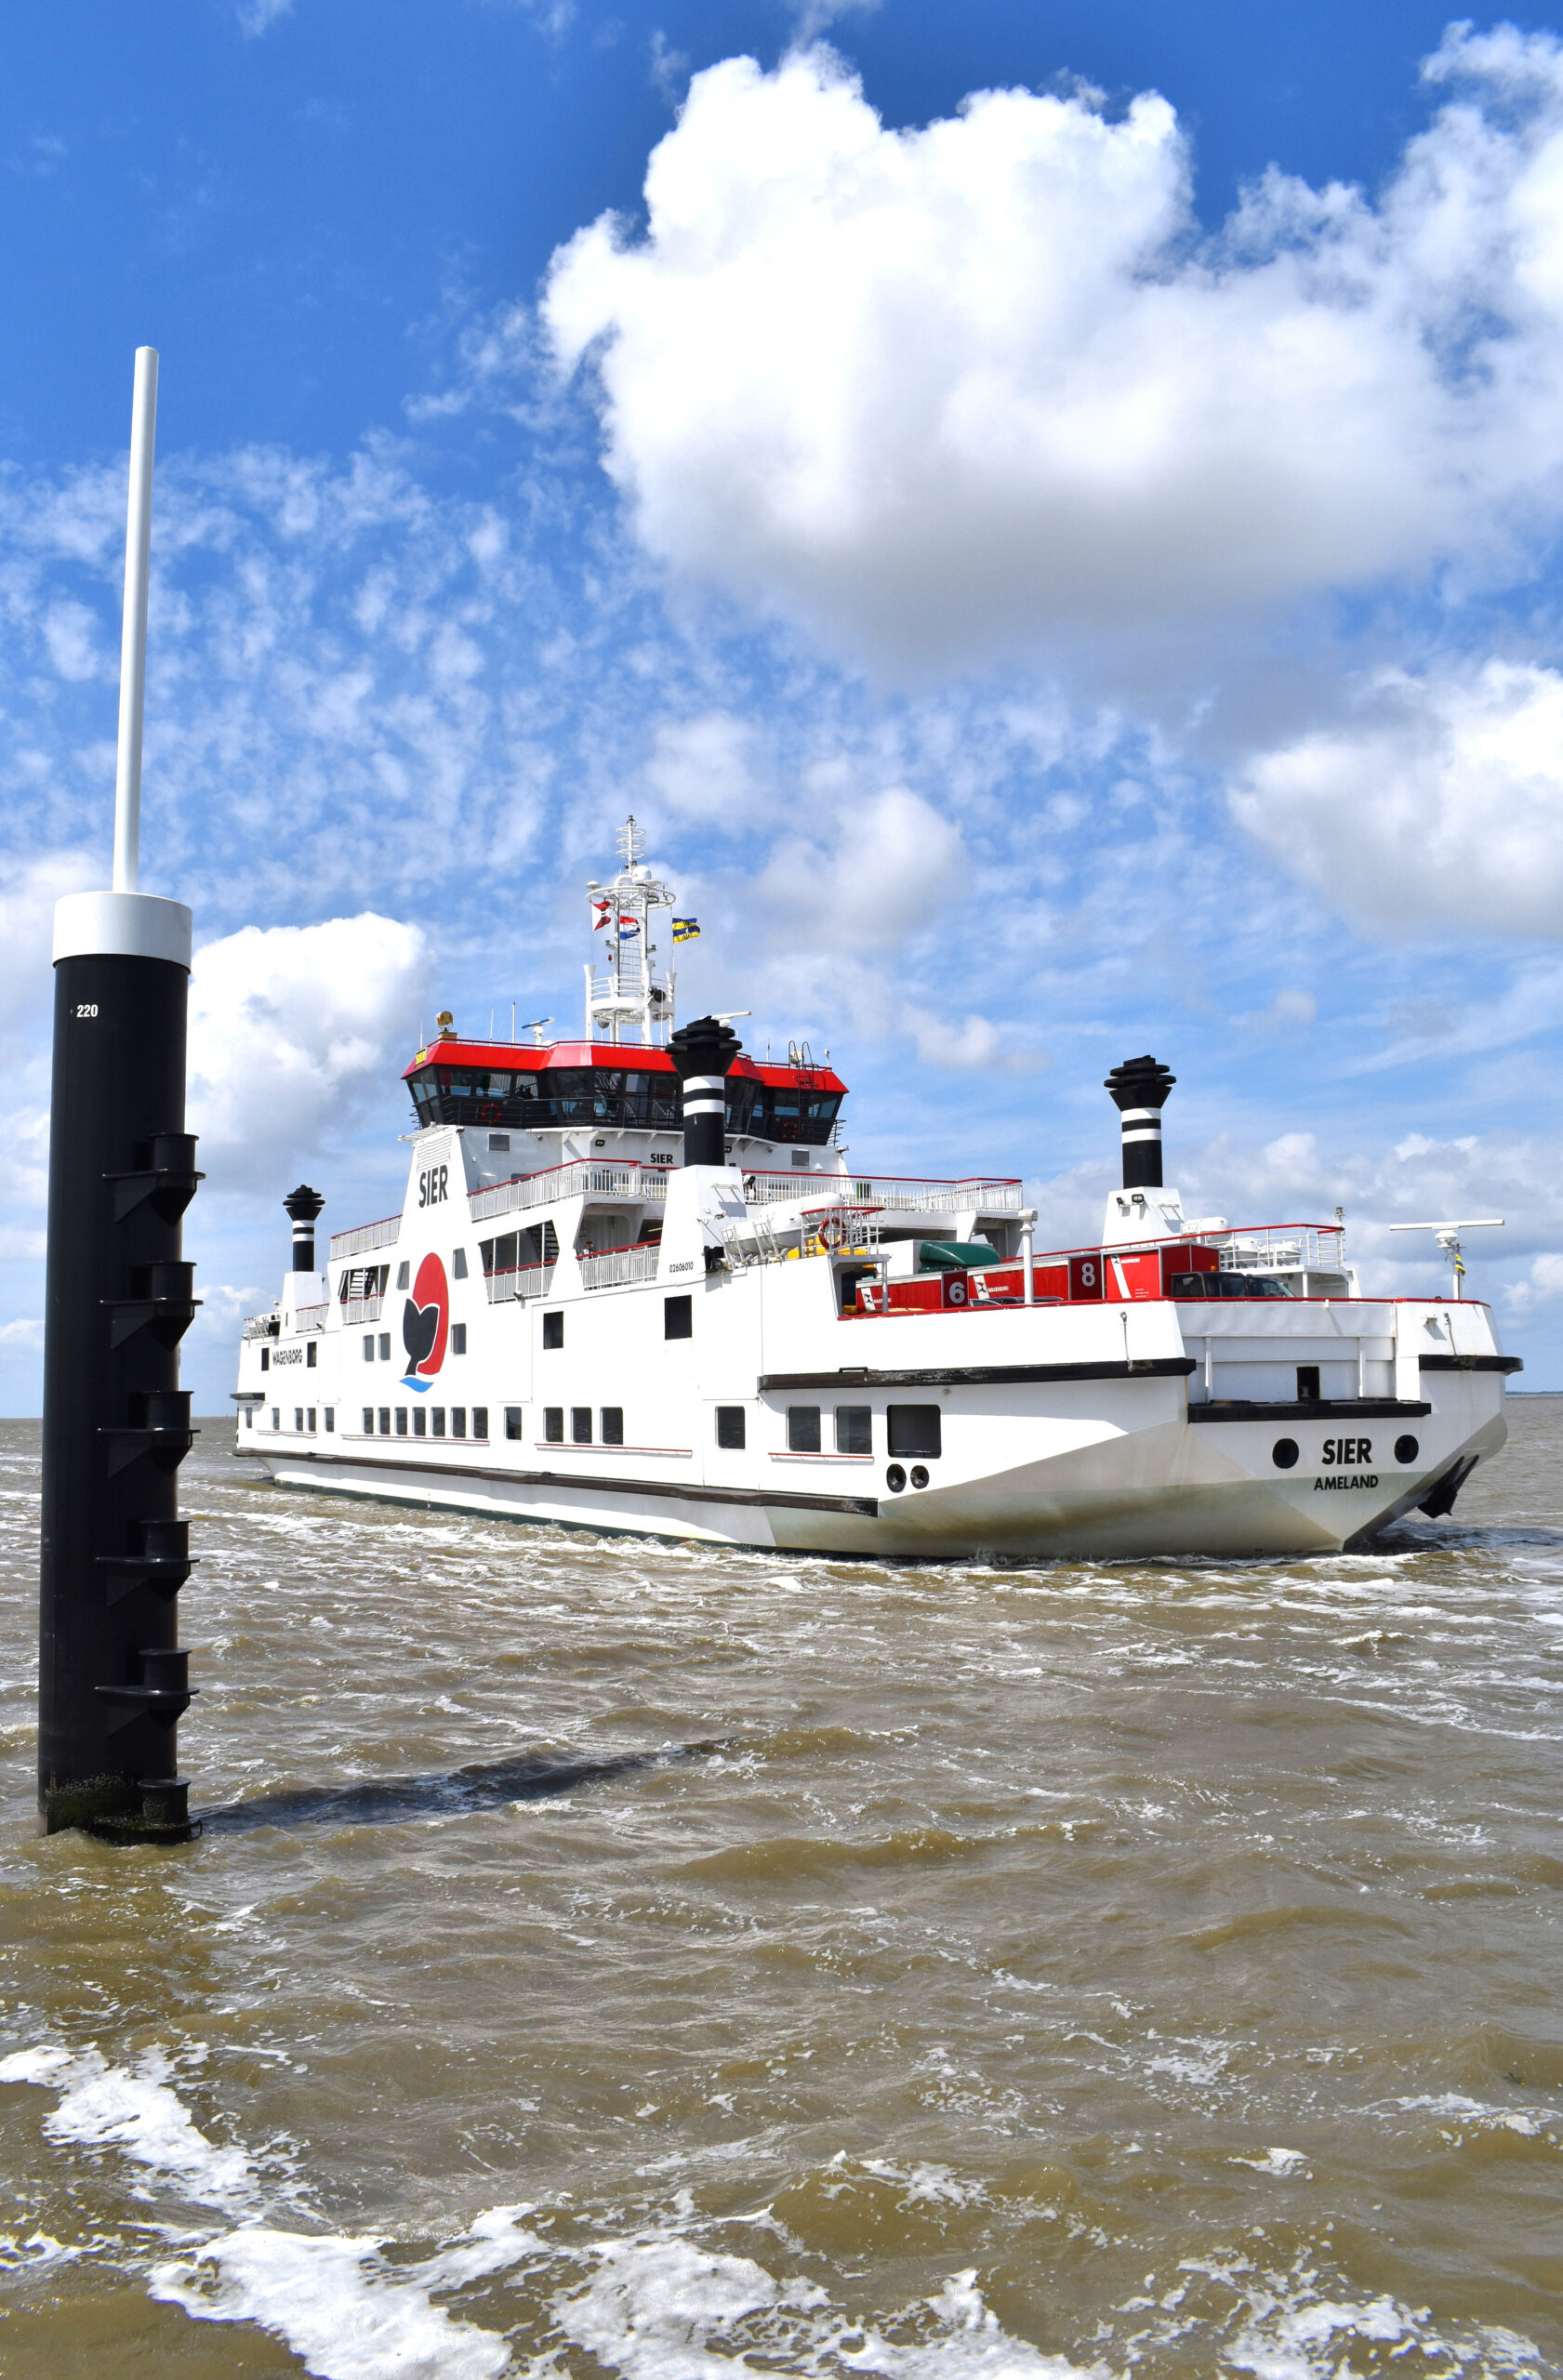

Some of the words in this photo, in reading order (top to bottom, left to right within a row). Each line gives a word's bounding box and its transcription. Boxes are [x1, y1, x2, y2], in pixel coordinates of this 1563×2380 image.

[76, 1004, 98, 1017] 220
[651, 1153, 673, 1164] SIER
[418, 1165, 448, 1208] SIER
[1082, 1263, 1095, 1287] 8
[949, 1282, 965, 1304] 6
[272, 1349, 302, 1366] WAGENBORG
[1321, 1438, 1372, 1465] SIER
[1314, 1475, 1378, 1491] AMELAND
